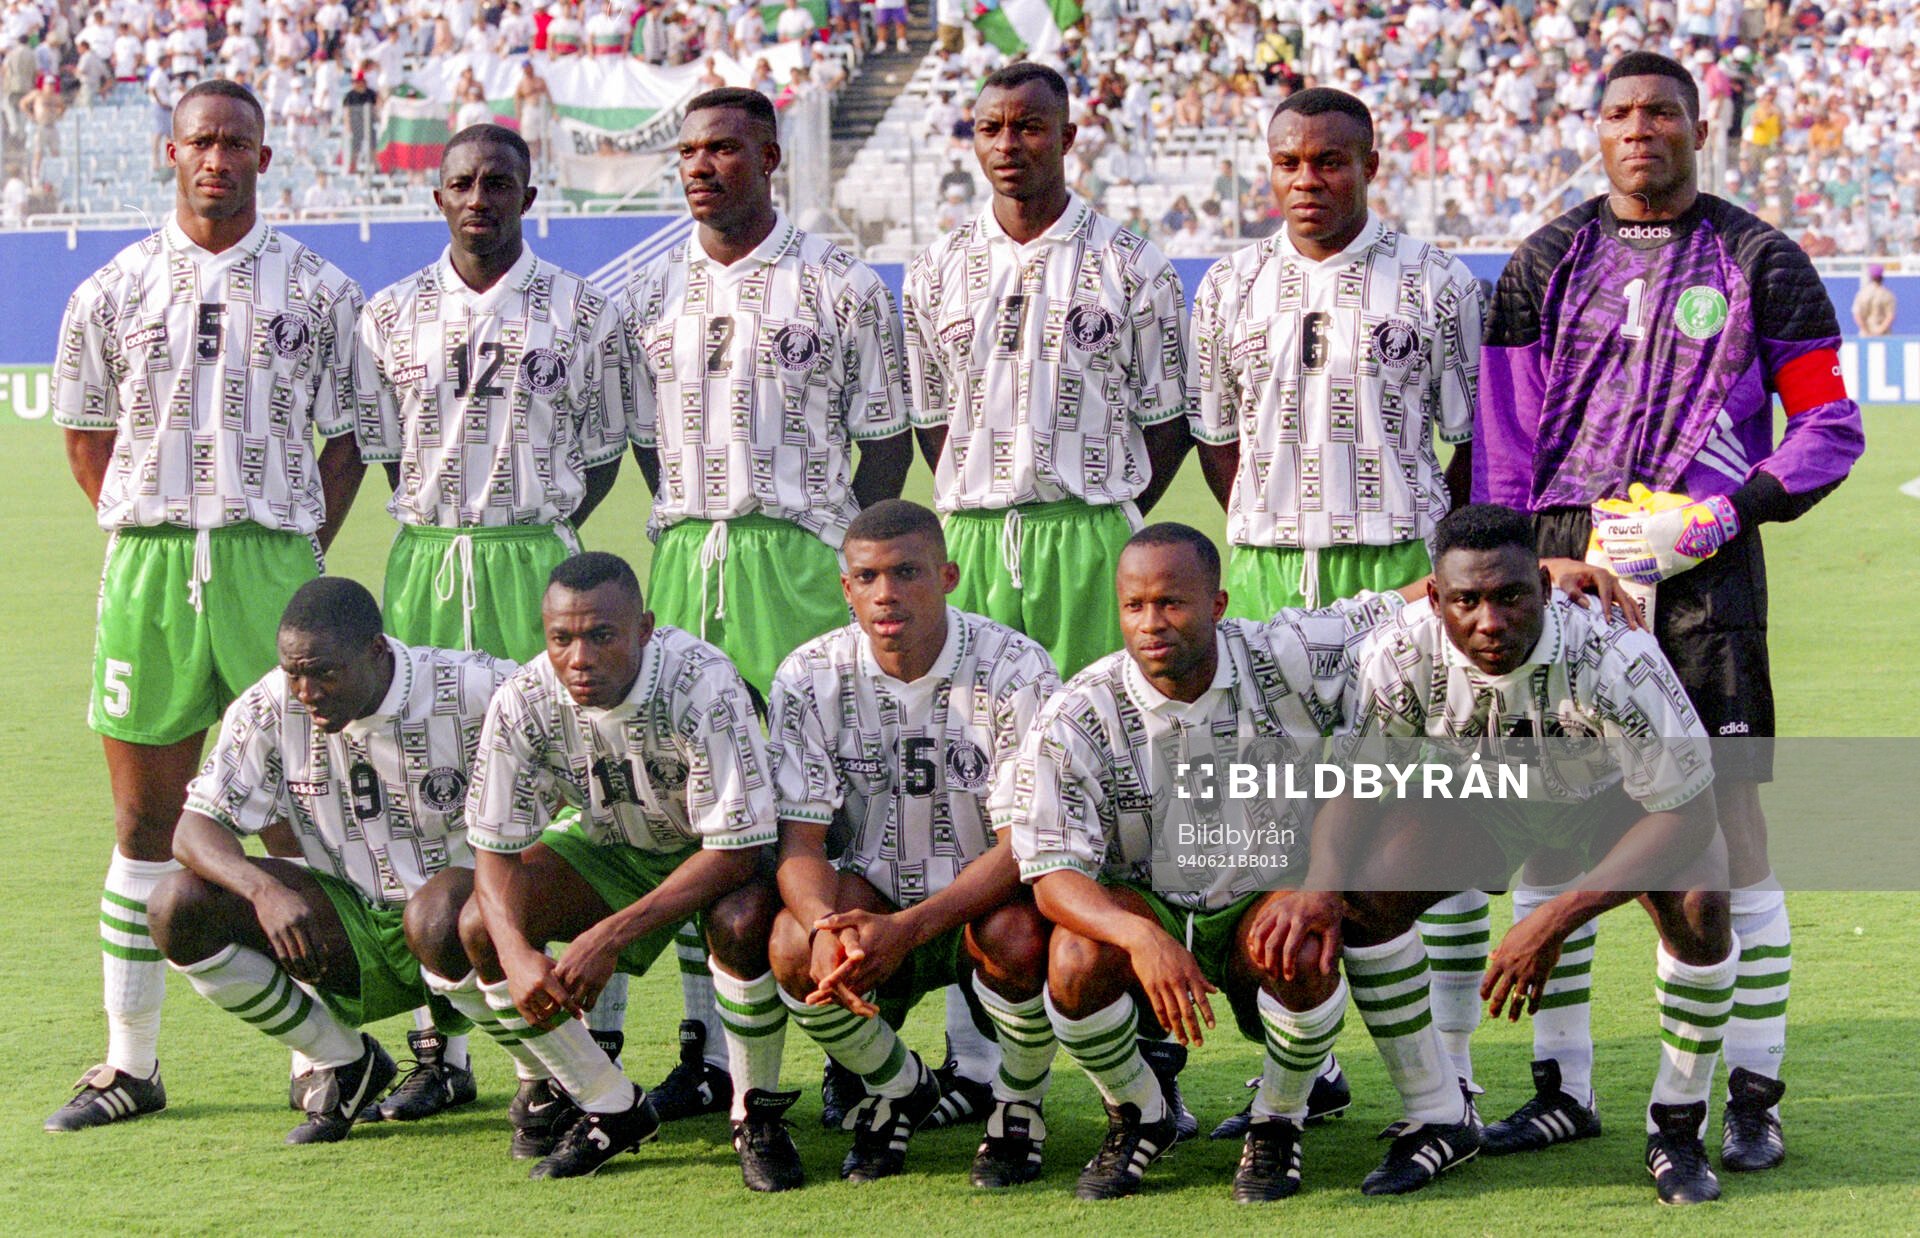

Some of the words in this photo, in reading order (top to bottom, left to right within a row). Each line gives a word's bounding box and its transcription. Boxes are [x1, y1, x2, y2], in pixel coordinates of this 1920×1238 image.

[1618, 225, 1672, 239] adidas
[197, 303, 228, 360] 5
[942, 320, 973, 342] adidas
[1620, 278, 1646, 340] 1
[127, 327, 167, 348] adidas
[708, 315, 735, 371] 2
[1233, 337, 1266, 360] adidas
[1303, 311, 1333, 369] 6
[394, 366, 427, 384] adidas
[451, 342, 507, 400] 12
[0, 372, 50, 420] U
[1608, 522, 1643, 535] reusch
[103, 657, 132, 718] 5
[288, 782, 328, 796] adidas
[350, 762, 385, 821] 9
[591, 757, 646, 809] 11
[1120, 799, 1152, 808] adid
